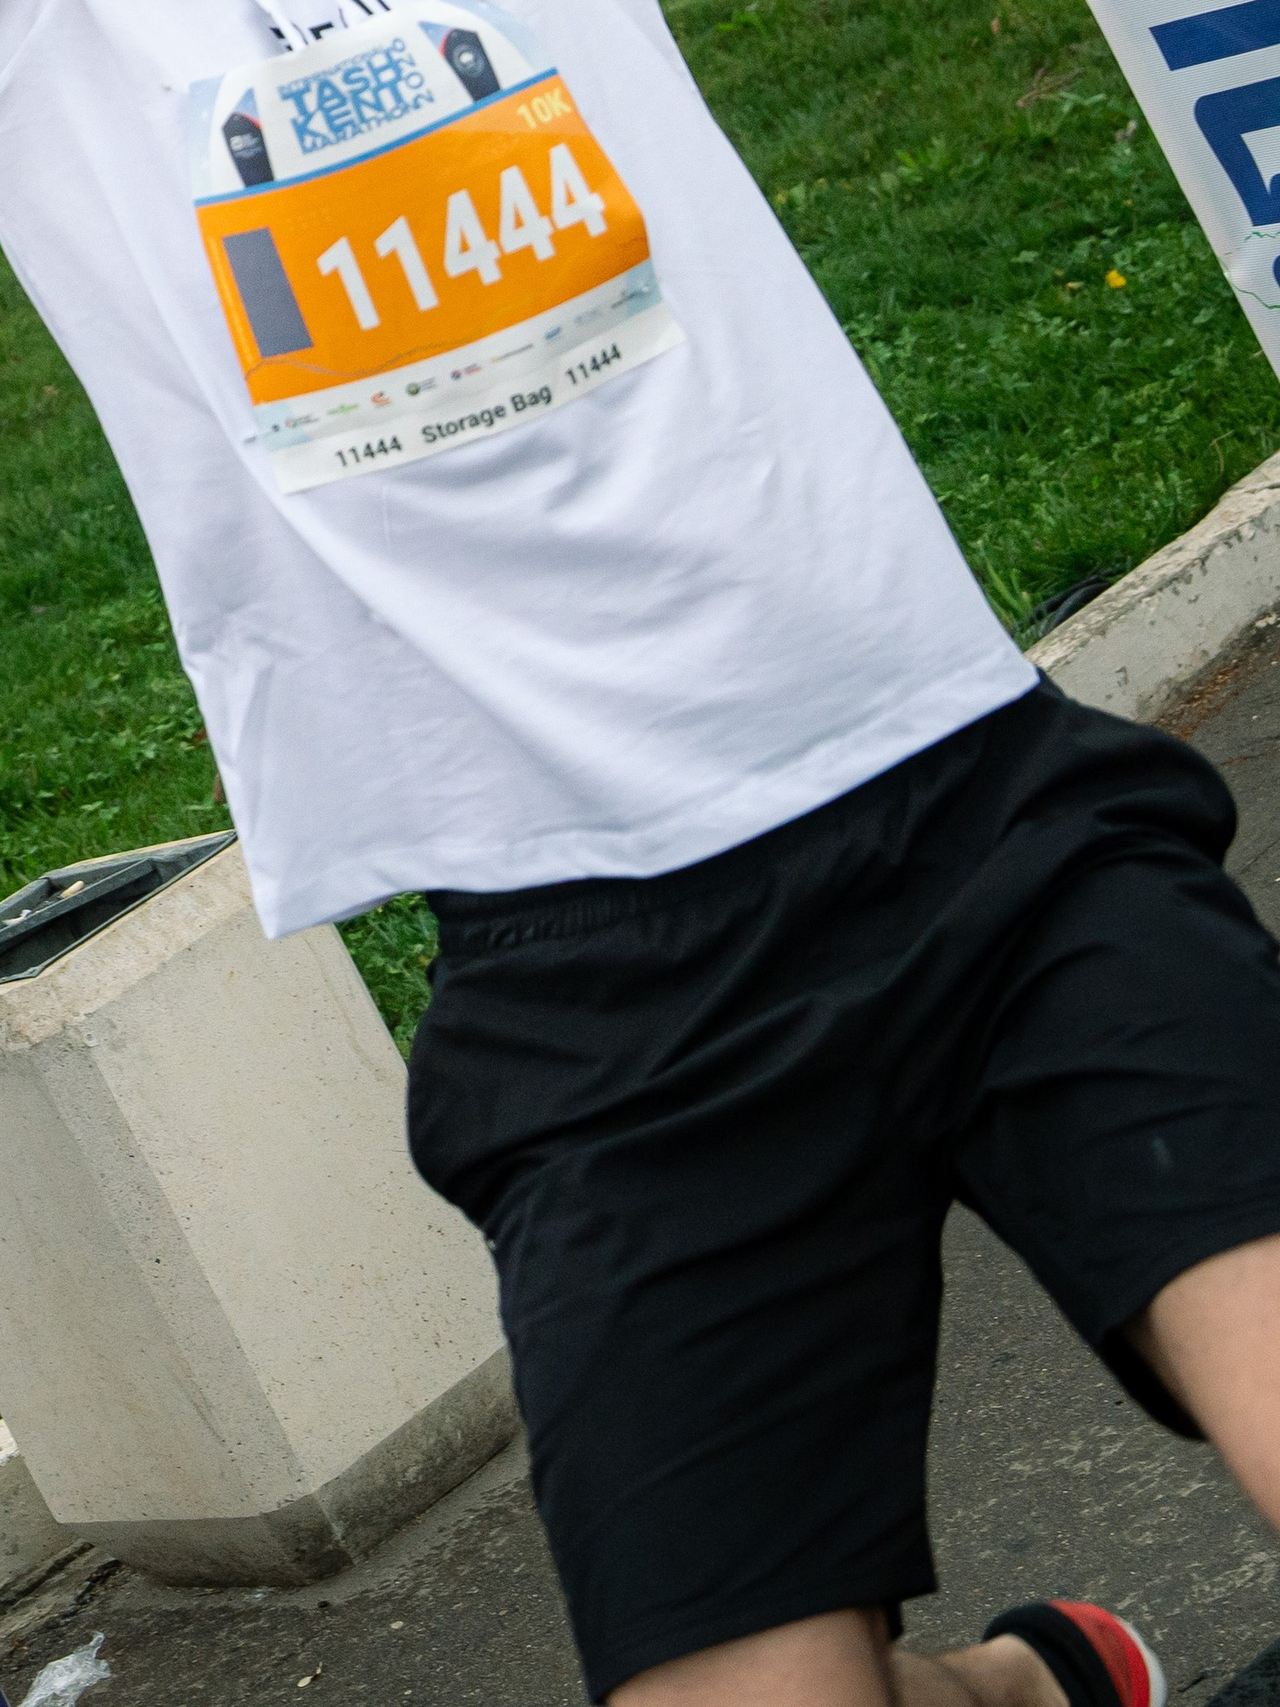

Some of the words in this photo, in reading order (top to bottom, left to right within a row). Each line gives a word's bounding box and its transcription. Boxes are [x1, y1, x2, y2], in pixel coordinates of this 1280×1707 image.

[278, 48, 404, 117] TASH
[516, 87, 571, 129] 10K
[317, 142, 608, 331] 11444
[335, 435, 403, 467] 11444
[421, 403, 507, 444] Storage
[512, 385, 554, 413] Bag
[564, 343, 622, 385] 11444
